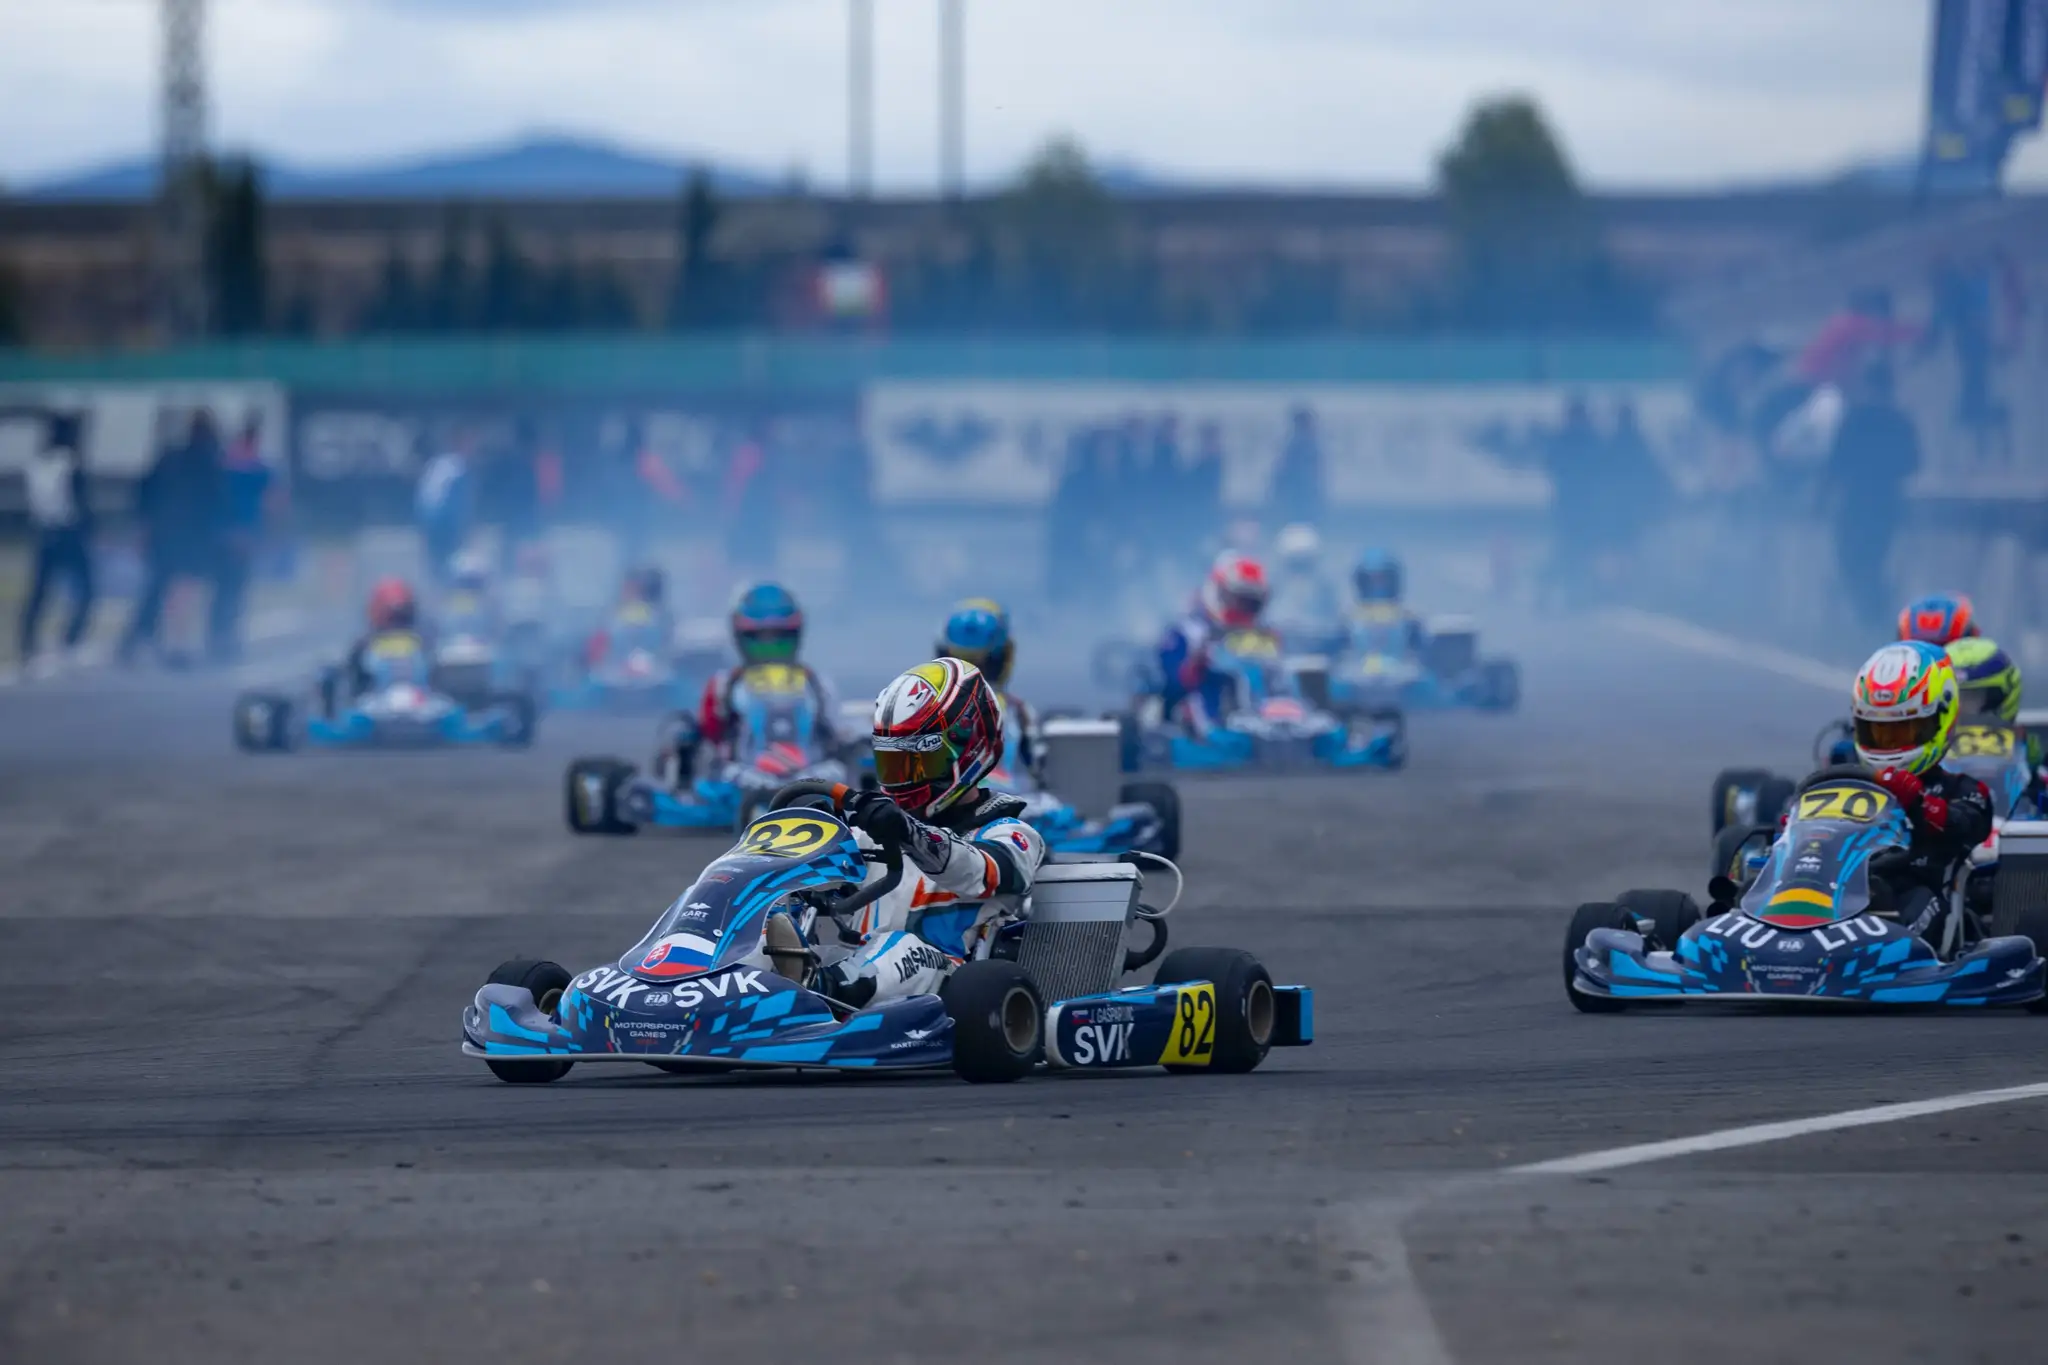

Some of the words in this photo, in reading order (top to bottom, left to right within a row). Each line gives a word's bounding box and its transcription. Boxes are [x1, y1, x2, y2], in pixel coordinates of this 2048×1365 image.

[917, 735, 942, 750] Arai
[1804, 791, 1878, 825] 70
[746, 823, 825, 857] 82
[681, 910, 709, 918] KART
[1705, 913, 1778, 949] LTU
[1812, 915, 1889, 951] LTU
[1751, 965, 1820, 973] MOTORSPORT
[576, 967, 650, 1009] SVK
[645, 992, 671, 1005] FIA
[672, 970, 770, 1008] SVK
[614, 1022, 687, 1031] MOTORSPORT
[629, 1031, 667, 1039] GAMES
[1178, 991, 1214, 1058] 82
[1073, 1023, 1135, 1065] SVK
